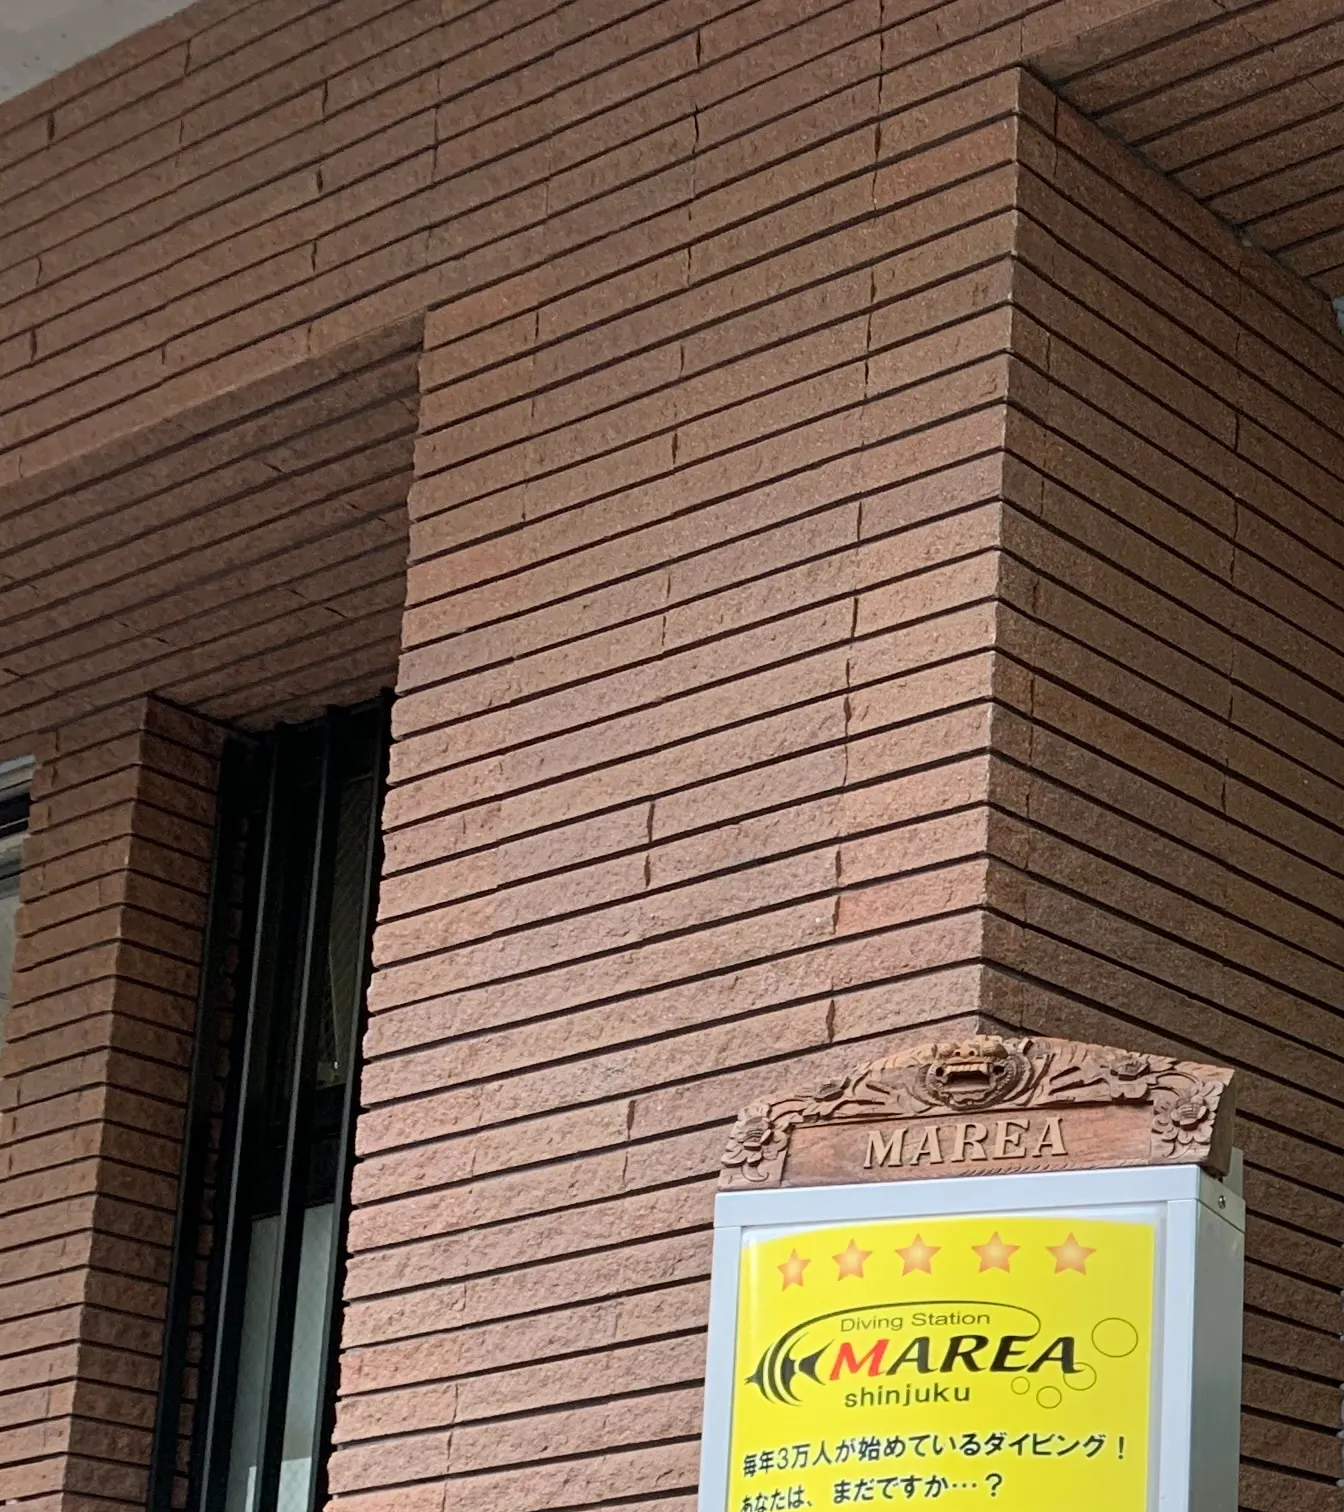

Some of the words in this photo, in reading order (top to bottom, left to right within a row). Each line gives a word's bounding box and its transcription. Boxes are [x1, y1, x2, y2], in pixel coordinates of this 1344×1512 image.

[863, 1117, 1070, 1170] MAREA
[840, 1313, 904, 1333] Diving
[911, 1310, 990, 1327] Station
[829, 1335, 1083, 1381] MAREA
[844, 1383, 971, 1408] shinjuku
